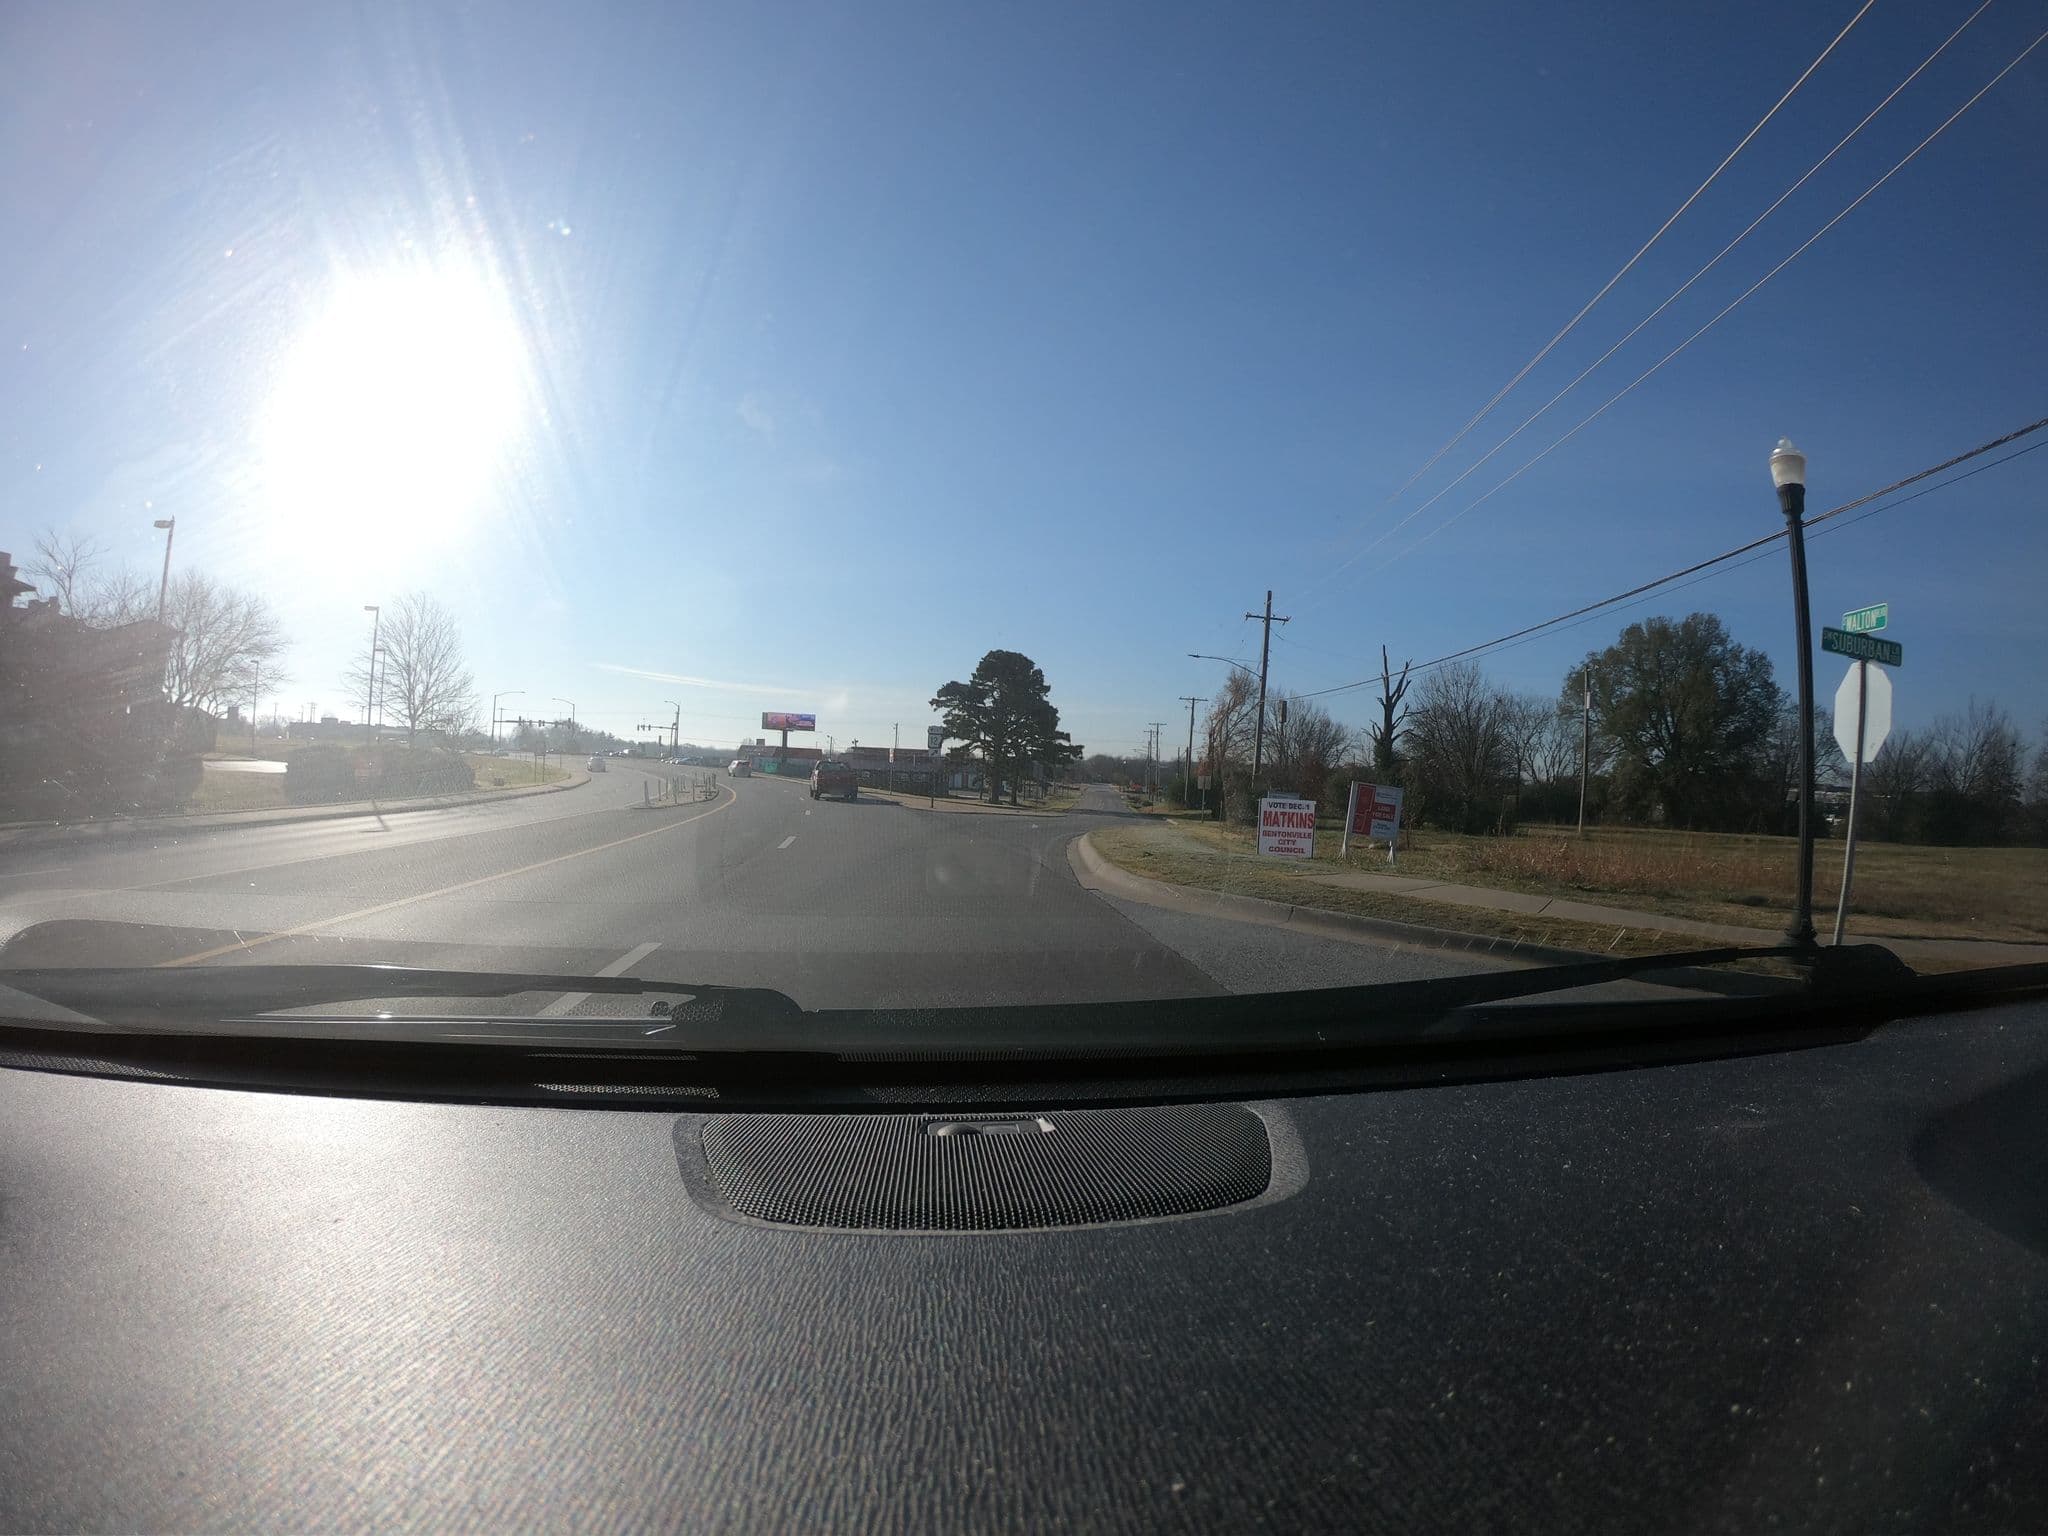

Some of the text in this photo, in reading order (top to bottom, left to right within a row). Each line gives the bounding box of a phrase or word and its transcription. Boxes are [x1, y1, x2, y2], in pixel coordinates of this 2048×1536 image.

[1846, 609, 1877, 632] WALTON
[1831, 632, 1890, 661] SUBURBAN
[1263, 810, 1314, 829] MATKINS
[1262, 830, 1312, 839] BENTONVILLE
[1268, 846, 1306, 854] COUNCIL
